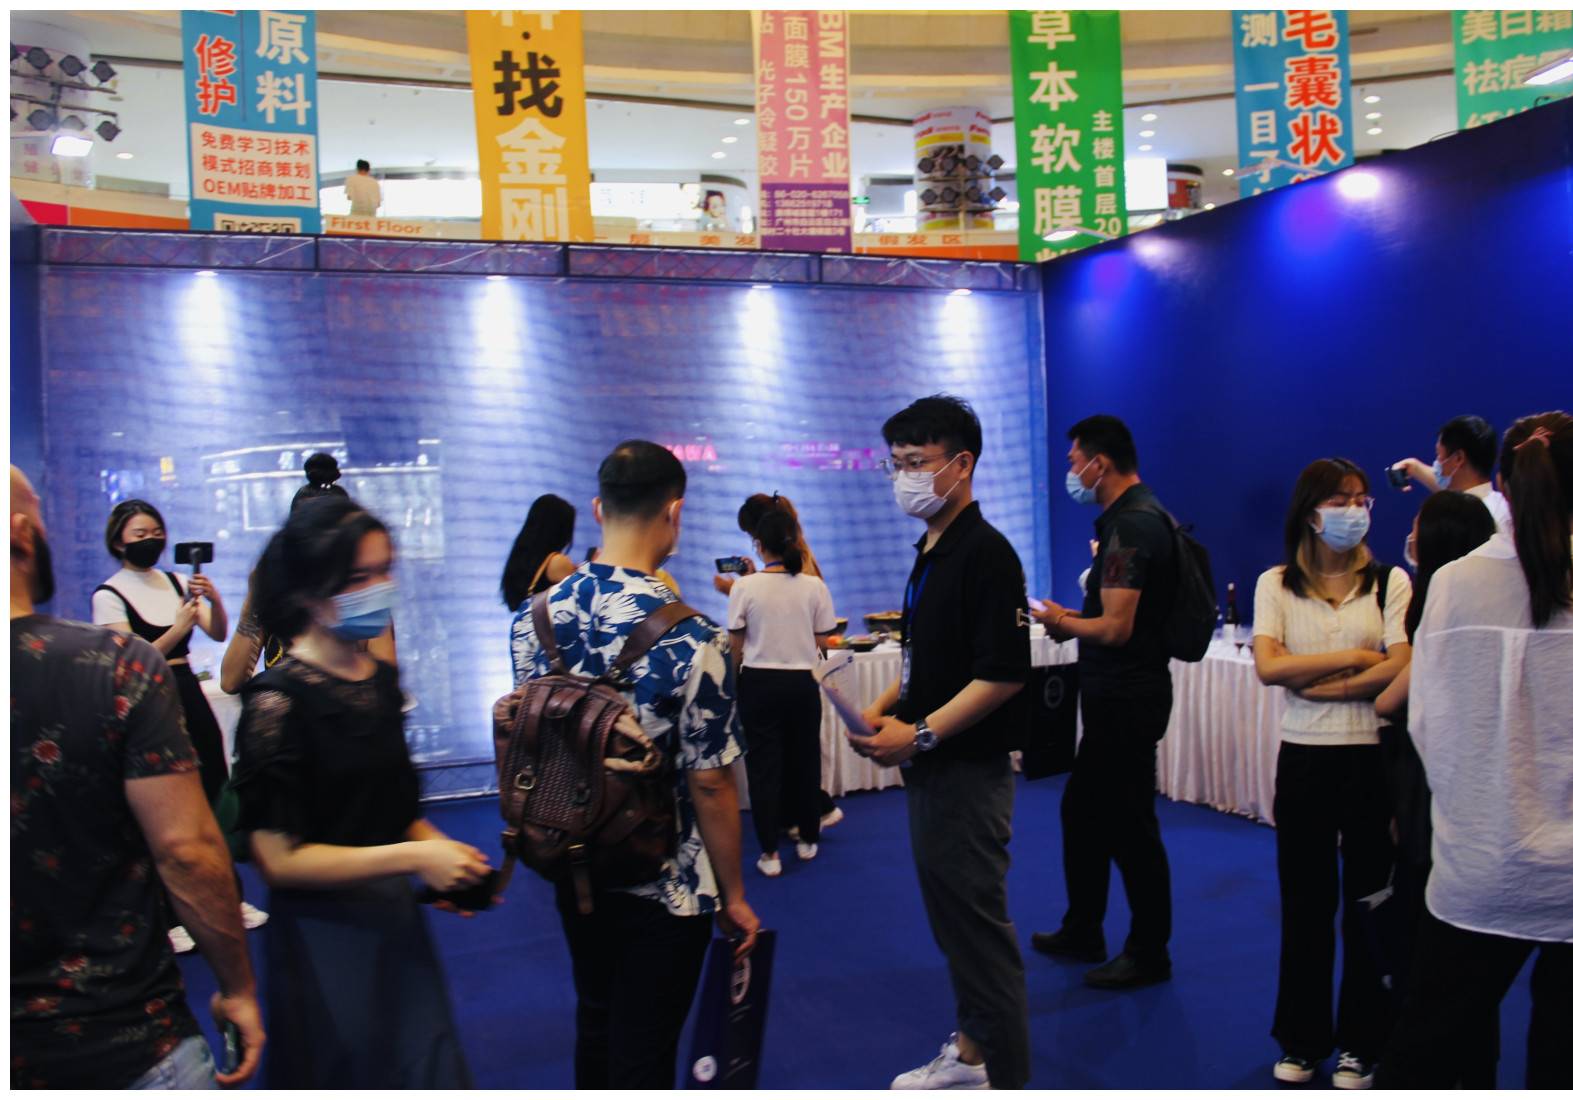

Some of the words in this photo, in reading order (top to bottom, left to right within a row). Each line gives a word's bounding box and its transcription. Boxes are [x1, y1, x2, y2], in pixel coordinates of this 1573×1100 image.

[194, 33, 238, 117] 修护
[256, 10, 312, 125] 原料
[1027, 10, 1083, 236] 草本软膜
[202, 131, 311, 155] 免费学习技术
[202, 154, 311, 180] 模式招商策划
[203, 178, 312, 201] OEM贴牌加工
[331, 216, 371, 231] First
[377, 220, 423, 234] Floor
